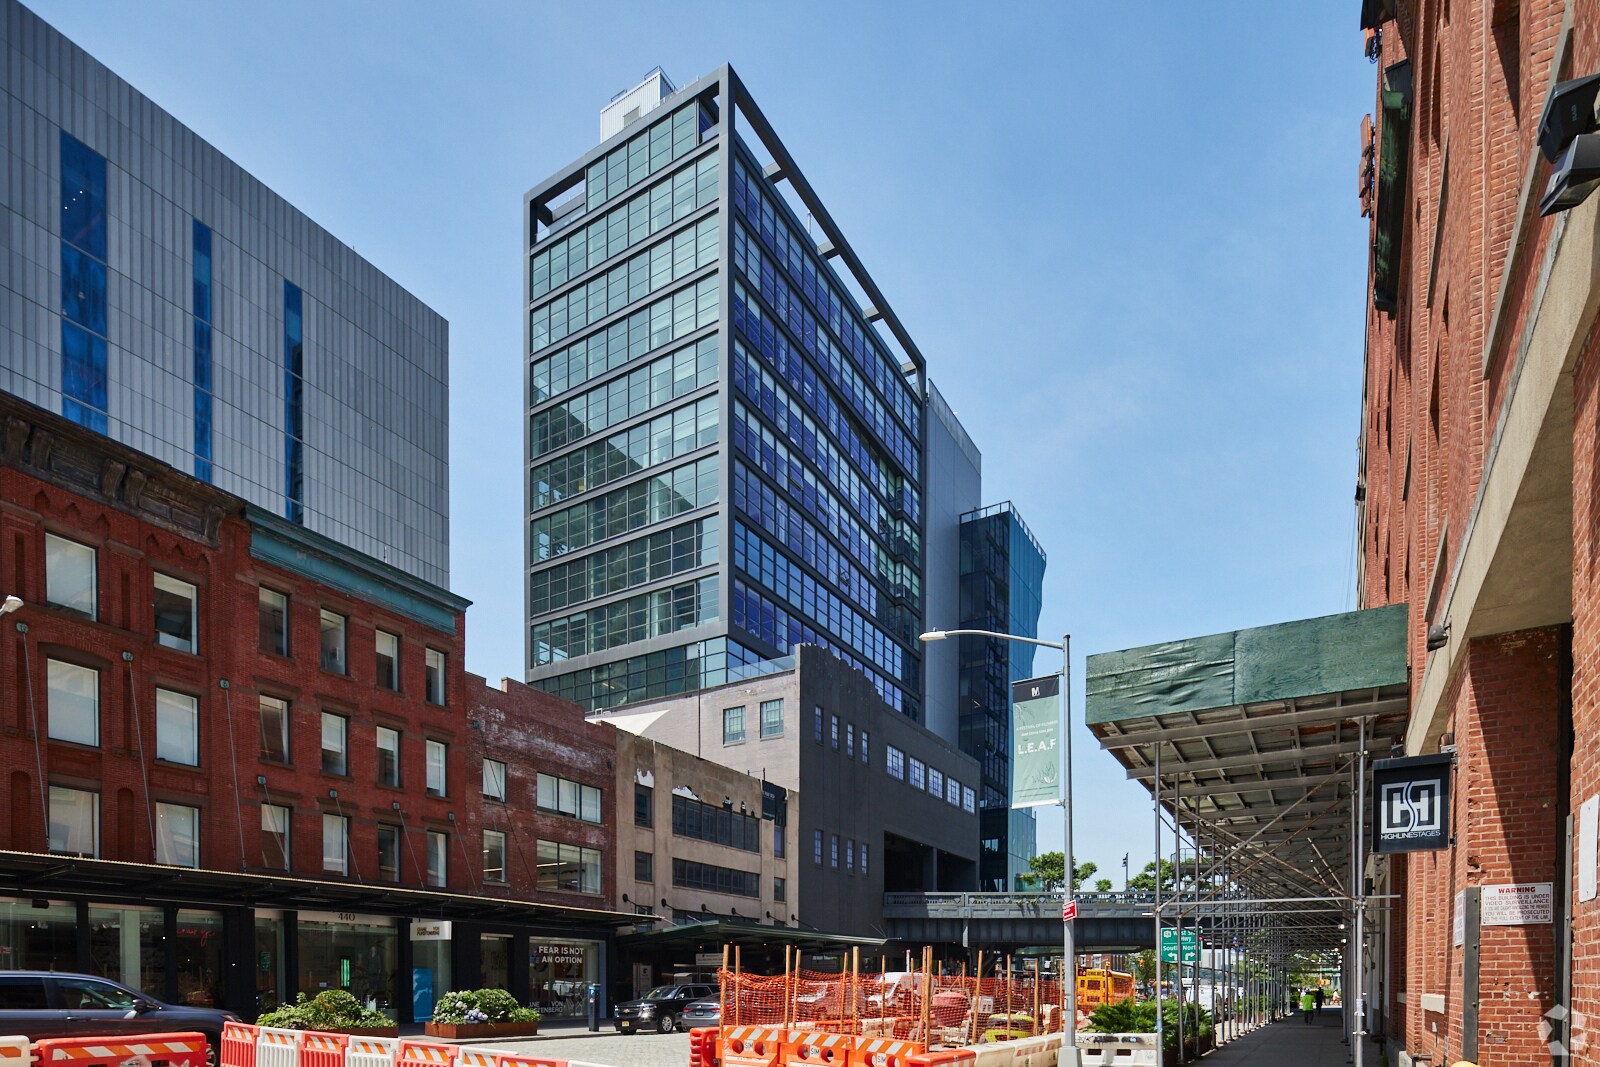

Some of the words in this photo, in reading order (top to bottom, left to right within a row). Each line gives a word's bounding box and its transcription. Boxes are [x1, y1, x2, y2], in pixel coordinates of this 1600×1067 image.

[338, 913, 355, 921] 440
[538, 946, 559, 954] FEAR
[561, 947, 569, 955] IS
[570, 947, 584, 955] NOT
[554, 956, 582, 964] OPTION
